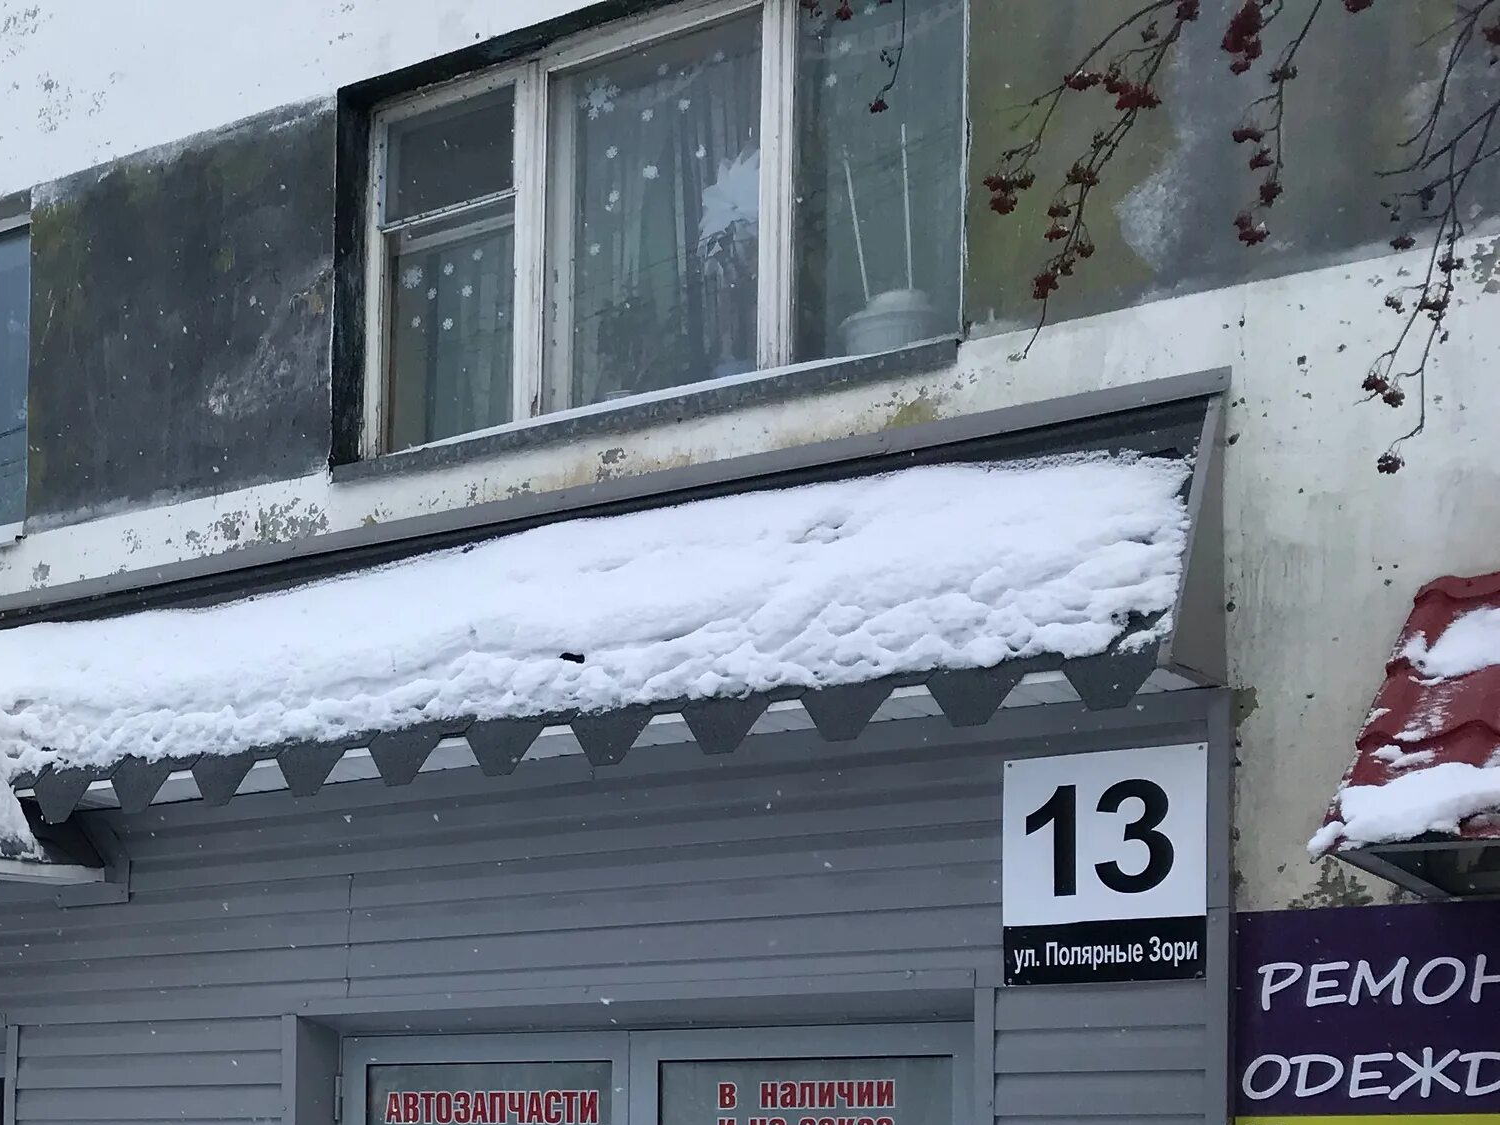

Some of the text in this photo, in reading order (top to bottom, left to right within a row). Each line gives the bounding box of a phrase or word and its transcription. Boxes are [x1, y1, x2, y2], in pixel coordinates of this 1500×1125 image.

[1025, 778, 1175, 897] 13
[1013, 936, 1198, 974] ул. Полярные Зори
[385, 1089, 600, 1125] АВТОЗАПЧАСТИ
[760, 1079, 895, 1109] наличии
